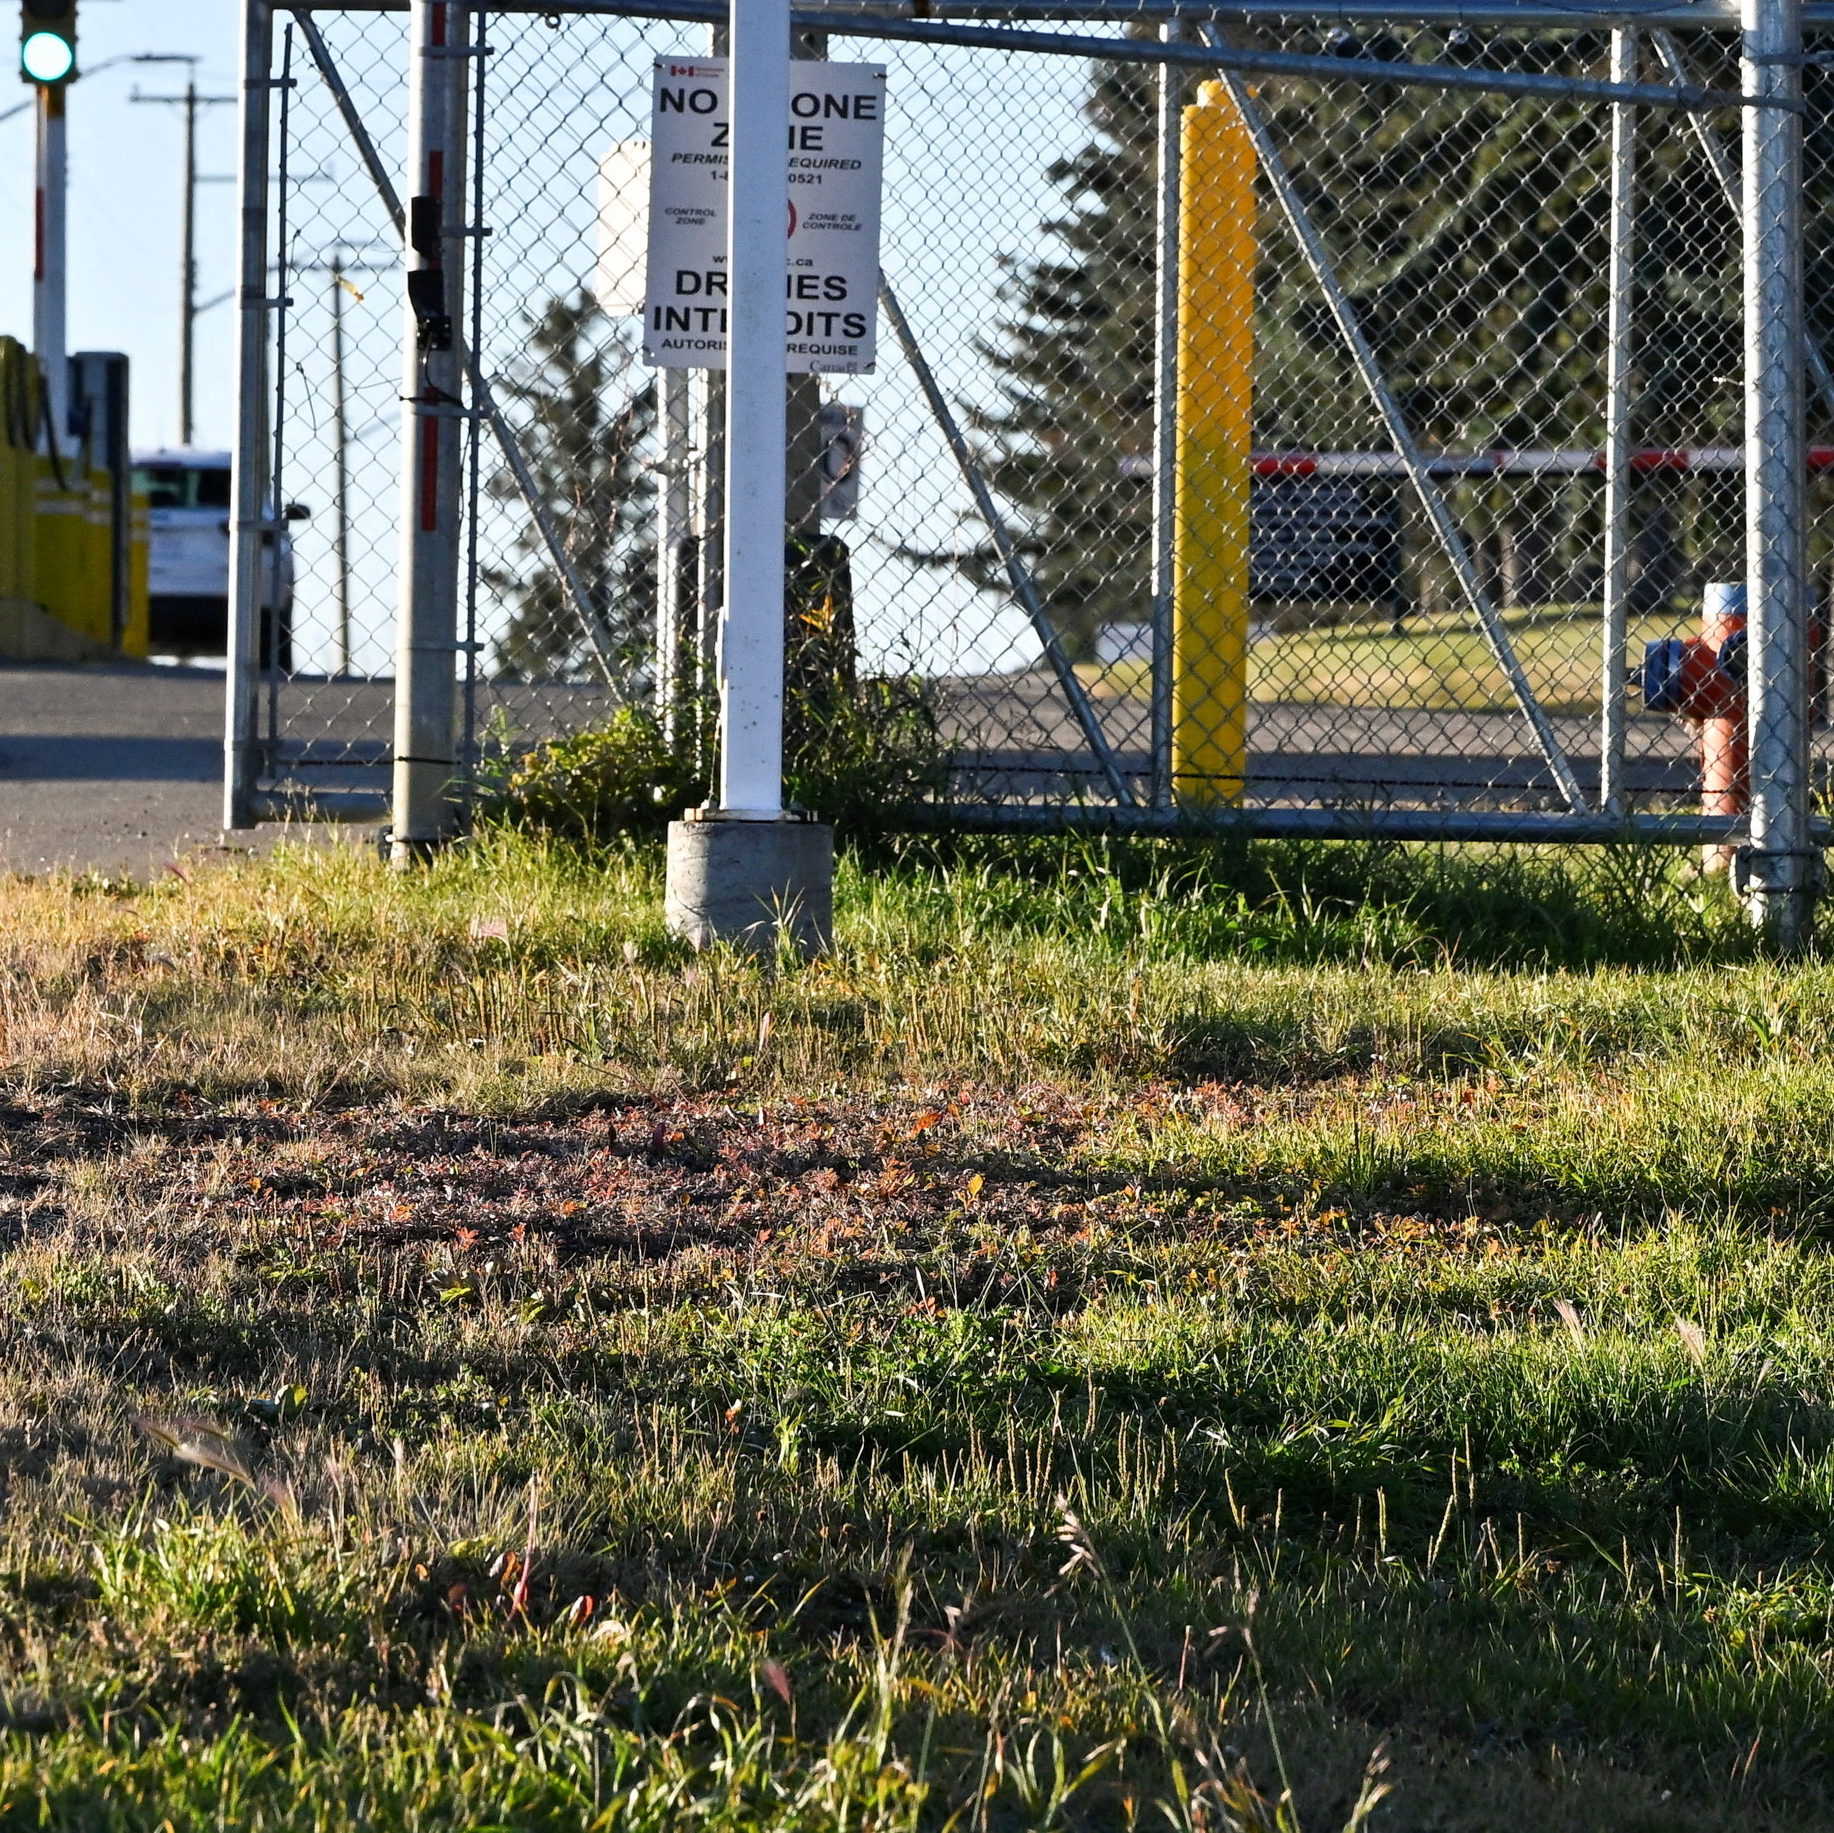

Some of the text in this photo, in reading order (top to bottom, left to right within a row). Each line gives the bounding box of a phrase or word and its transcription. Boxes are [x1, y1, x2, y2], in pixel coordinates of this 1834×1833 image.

[659, 87, 877, 120] NO ONE
[710, 121, 824, 151] ZE
[789, 156, 862, 170] EQUIRED
[675, 269, 848, 302] DRES
[653, 305, 867, 339] INTDITS
[786, 343, 858, 356] REQUISE
